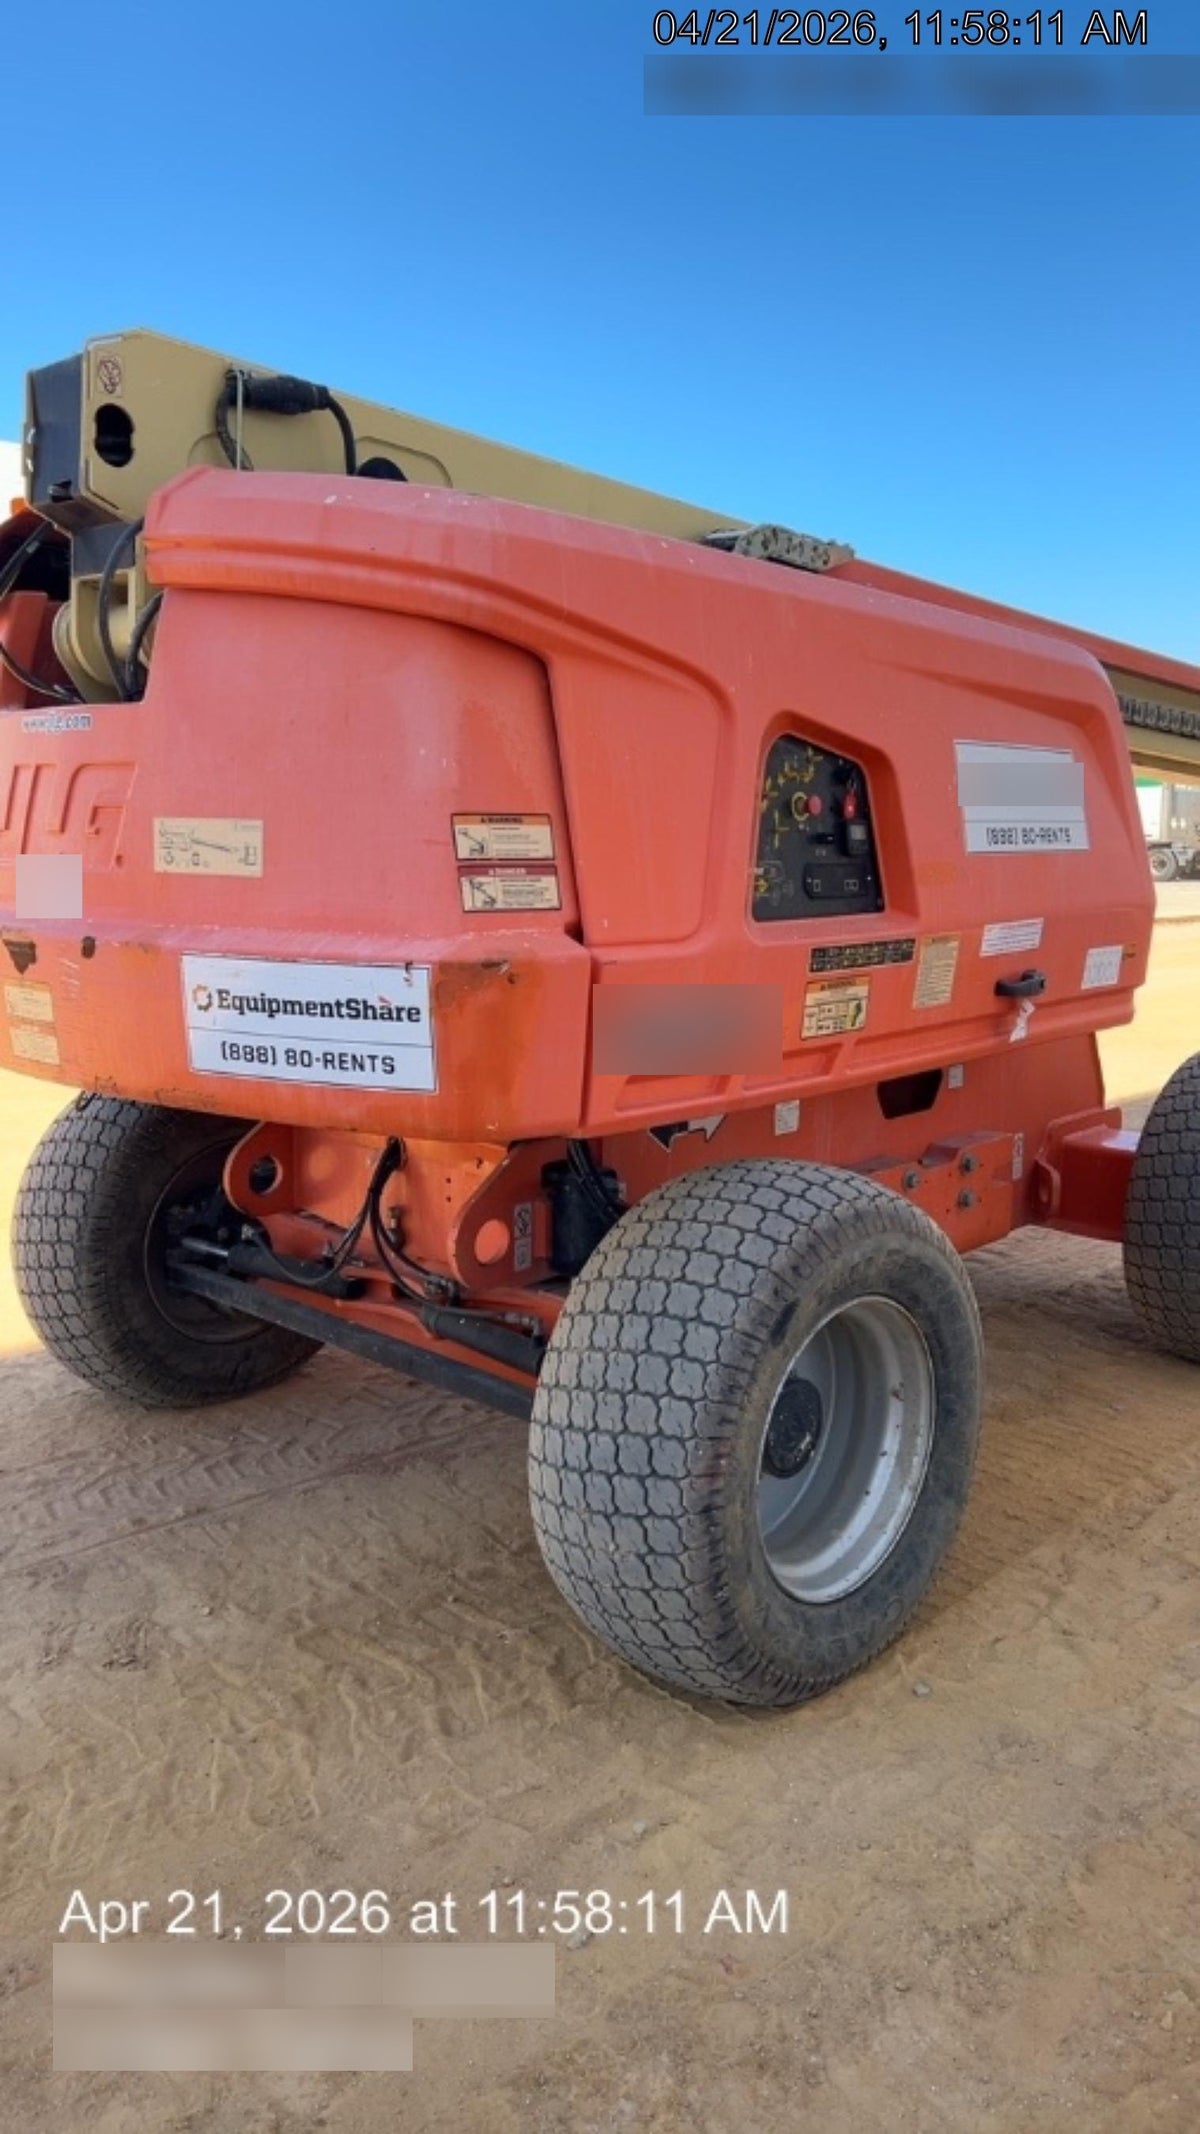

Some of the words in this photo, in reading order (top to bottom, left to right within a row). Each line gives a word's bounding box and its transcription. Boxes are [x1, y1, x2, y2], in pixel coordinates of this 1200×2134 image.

[216, 988, 422, 1023] EquipmentShare
[220, 1040, 277, 1066] (888)
[284, 1048, 396, 1075] 80-RENTS
